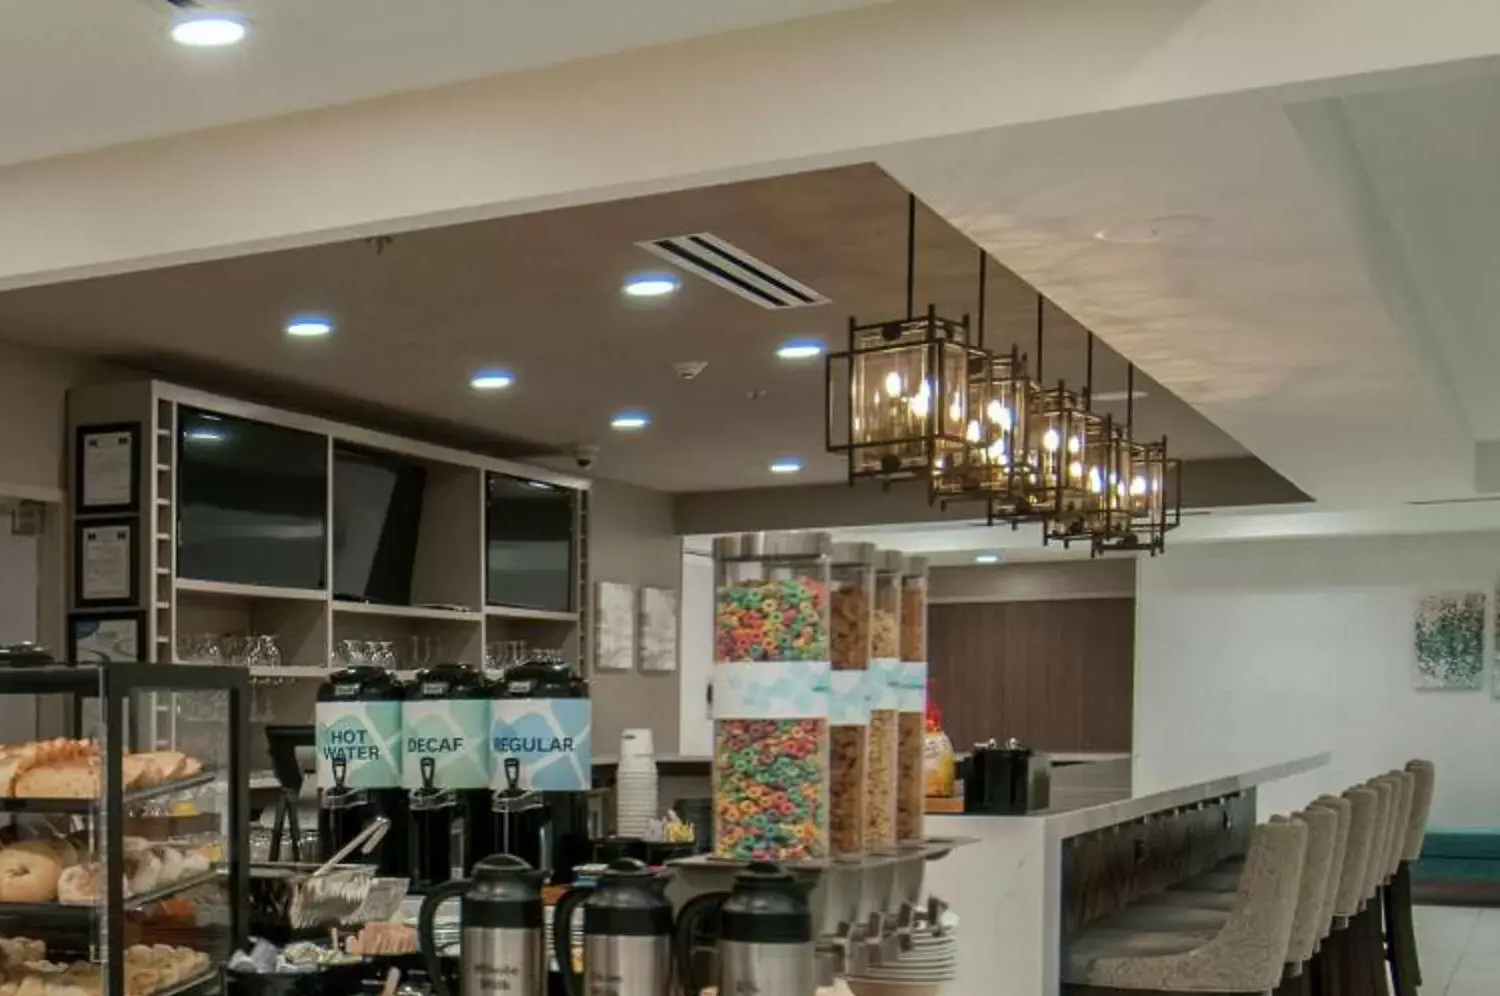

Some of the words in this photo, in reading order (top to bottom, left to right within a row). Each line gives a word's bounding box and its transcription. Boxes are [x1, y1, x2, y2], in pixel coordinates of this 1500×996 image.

[331, 730, 368, 744] HOT
[494, 736, 575, 752] REGULAR
[323, 745, 379, 760] WATER
[408, 737, 464, 753] DECAF
